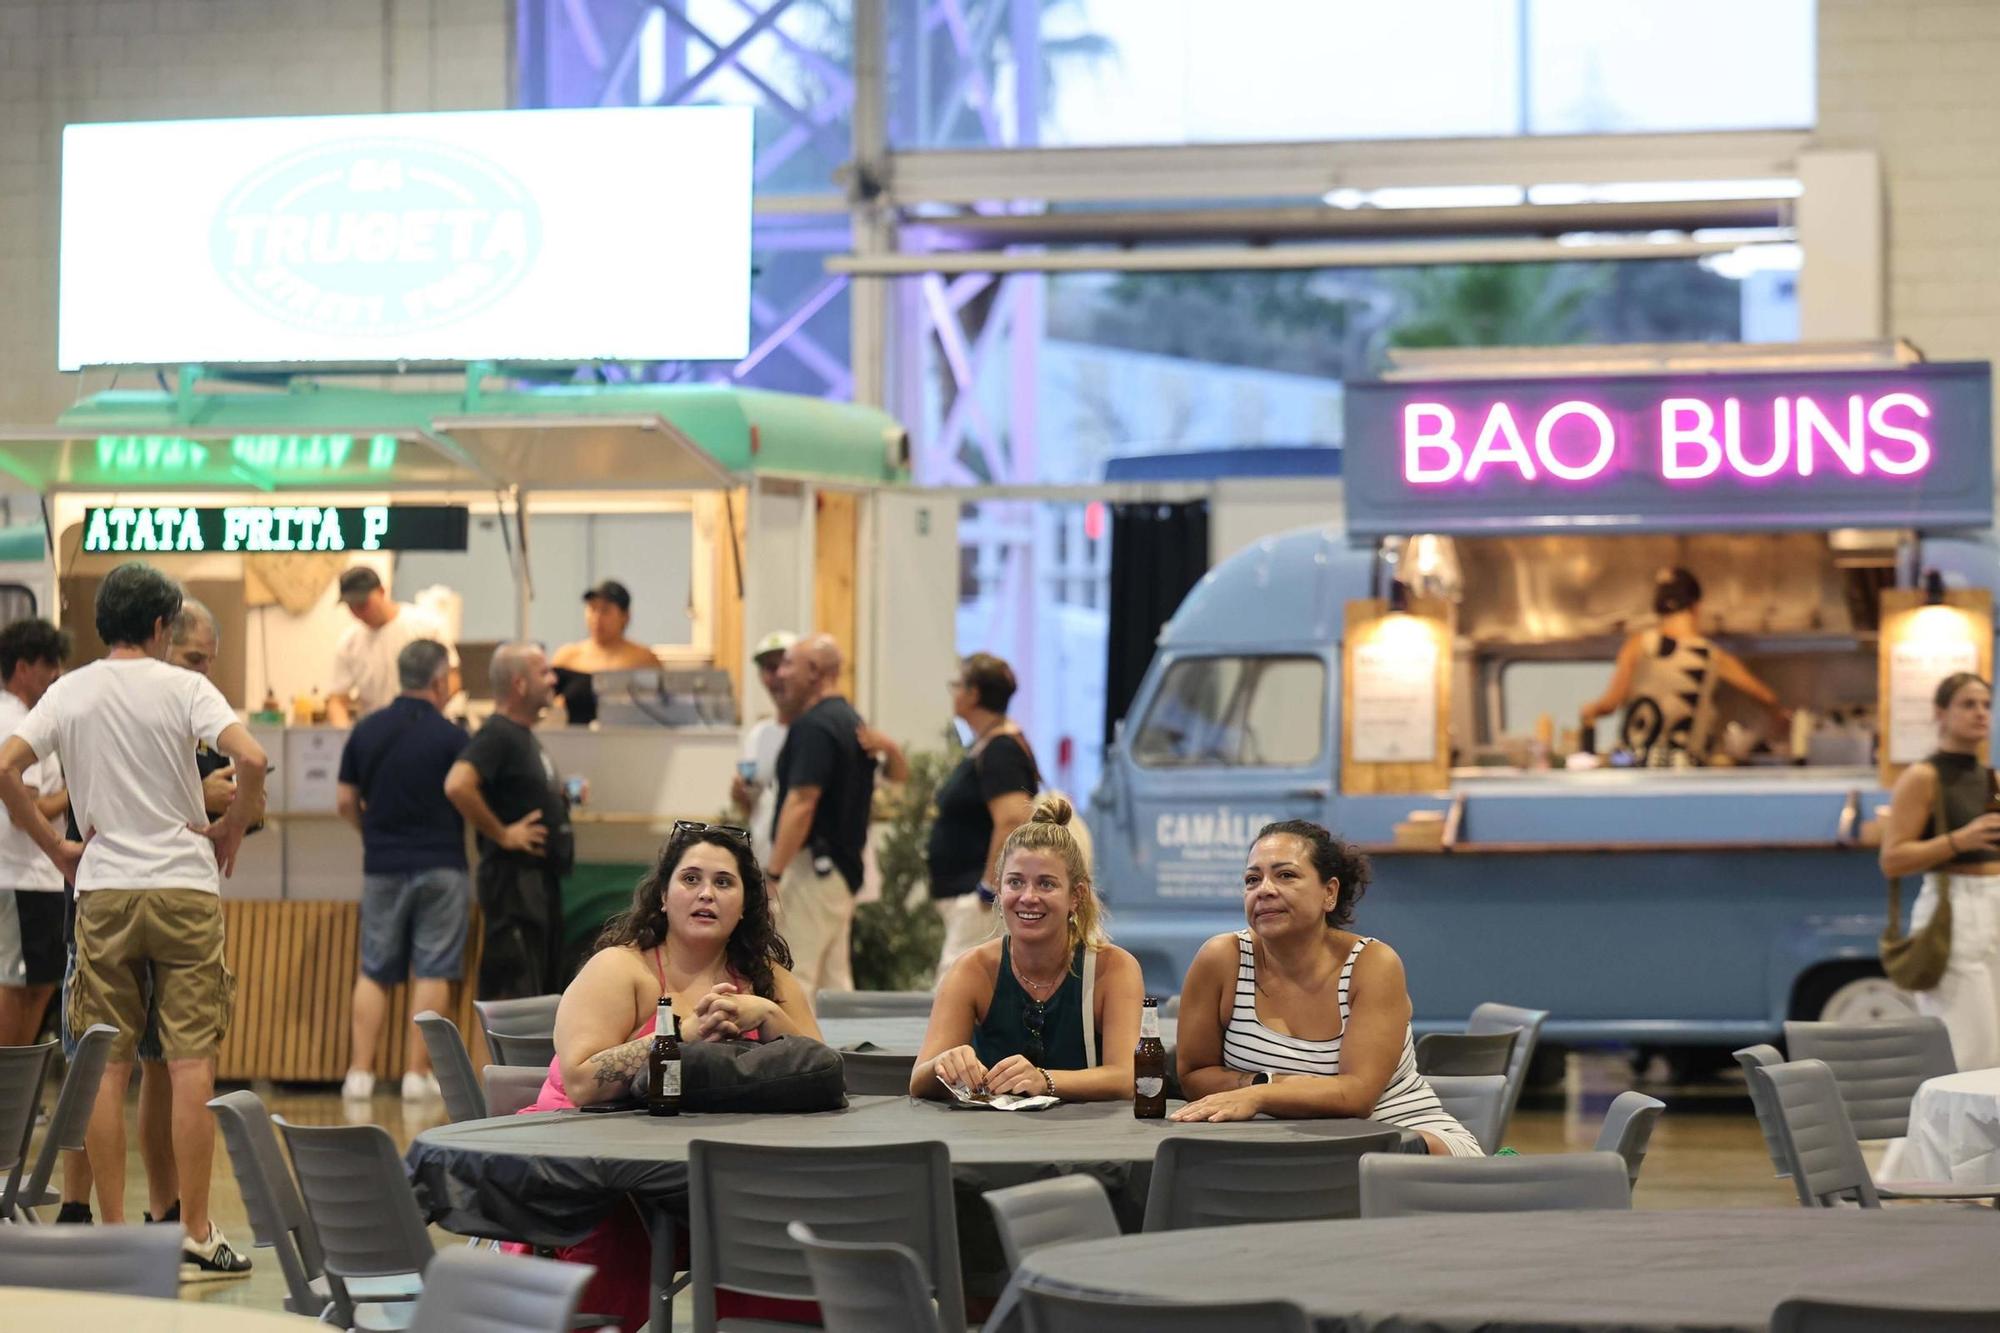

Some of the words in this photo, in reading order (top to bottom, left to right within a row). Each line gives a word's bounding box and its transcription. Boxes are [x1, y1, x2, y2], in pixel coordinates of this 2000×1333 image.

[226, 208, 527, 264] TRUGETA
[1403, 401, 1615, 483] BAO
[1661, 393, 1931, 479] BUNS
[85, 507, 204, 551] ATATA
[223, 506, 344, 551] FRITA
[362, 506, 389, 551] P
